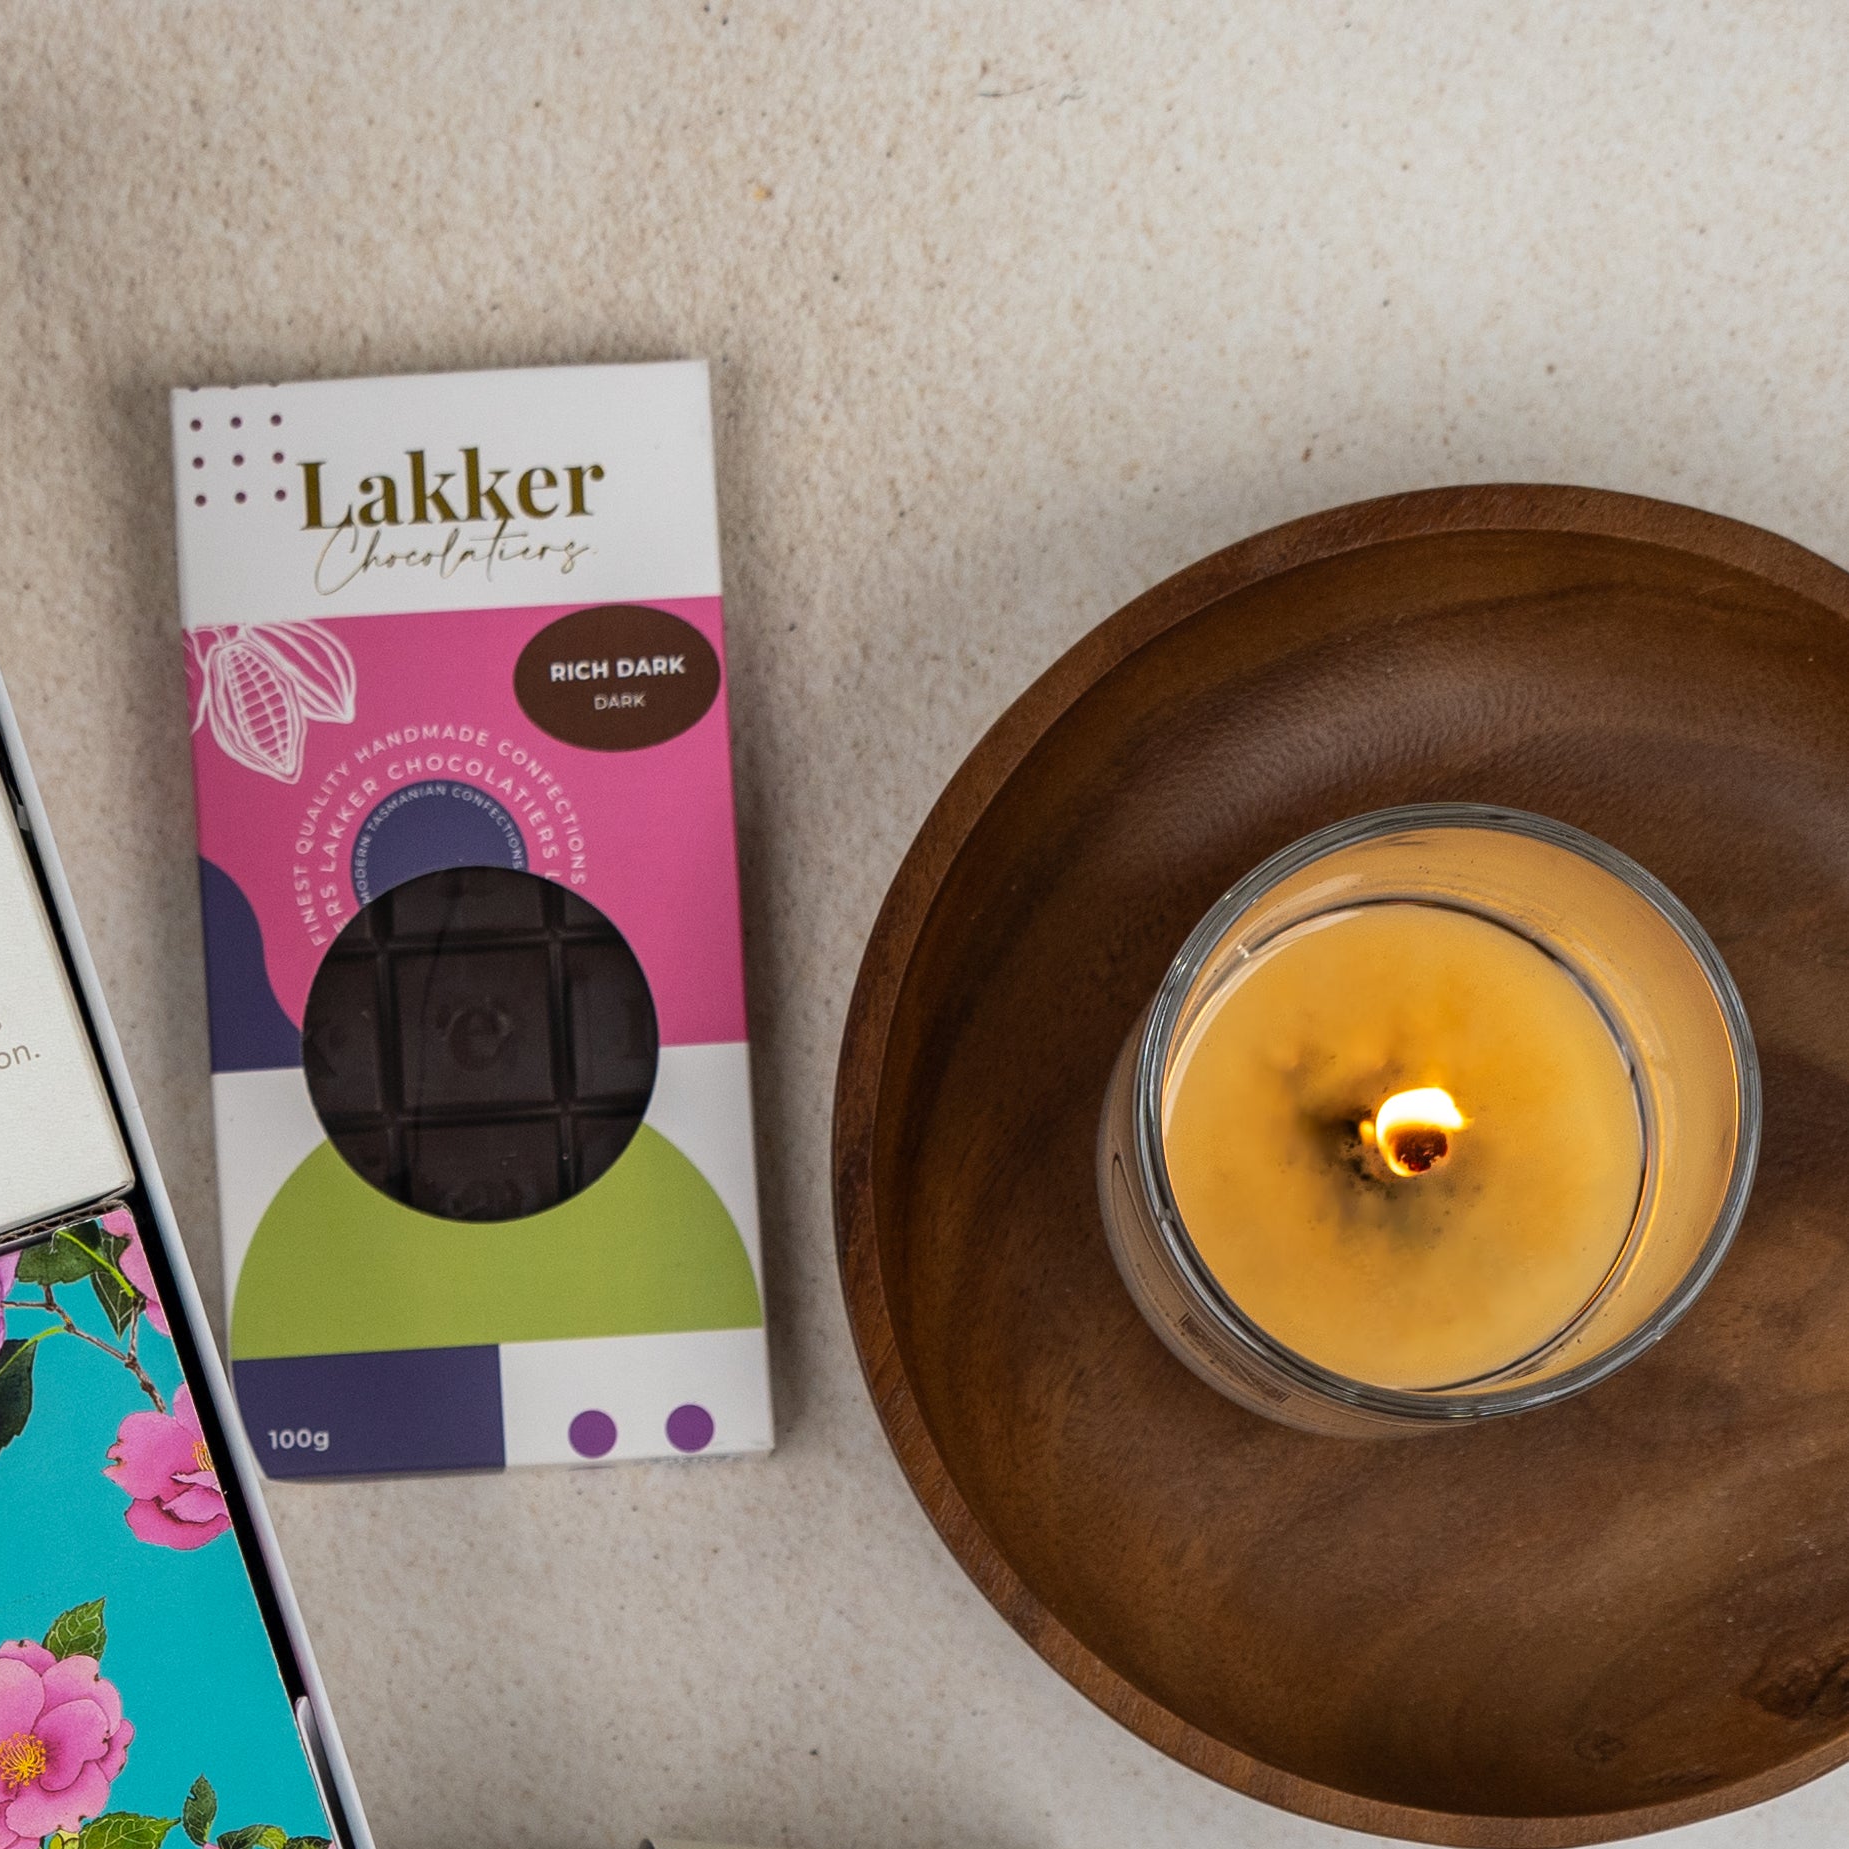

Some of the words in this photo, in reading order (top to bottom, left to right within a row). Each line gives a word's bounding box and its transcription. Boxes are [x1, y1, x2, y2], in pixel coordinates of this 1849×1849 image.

[297, 447, 606, 531] Lakker
[550, 661, 609, 682] RICH
[616, 656, 685, 678] DARK
[594, 694, 644, 710] DARK
[354, 724, 489, 763] HANDMADE
[295, 763, 349, 855] QUALITY
[320, 779, 378, 872] LAKKER
[388, 755, 559, 859] CHOCOLATIERS
[356, 836, 372, 904] MODERN
[367, 785, 446, 831] TASMANIAN
[497, 741, 586, 884] CONFECTIONS
[293, 866, 327, 946] FINEST
[268, 1428, 330, 1452] 100g
